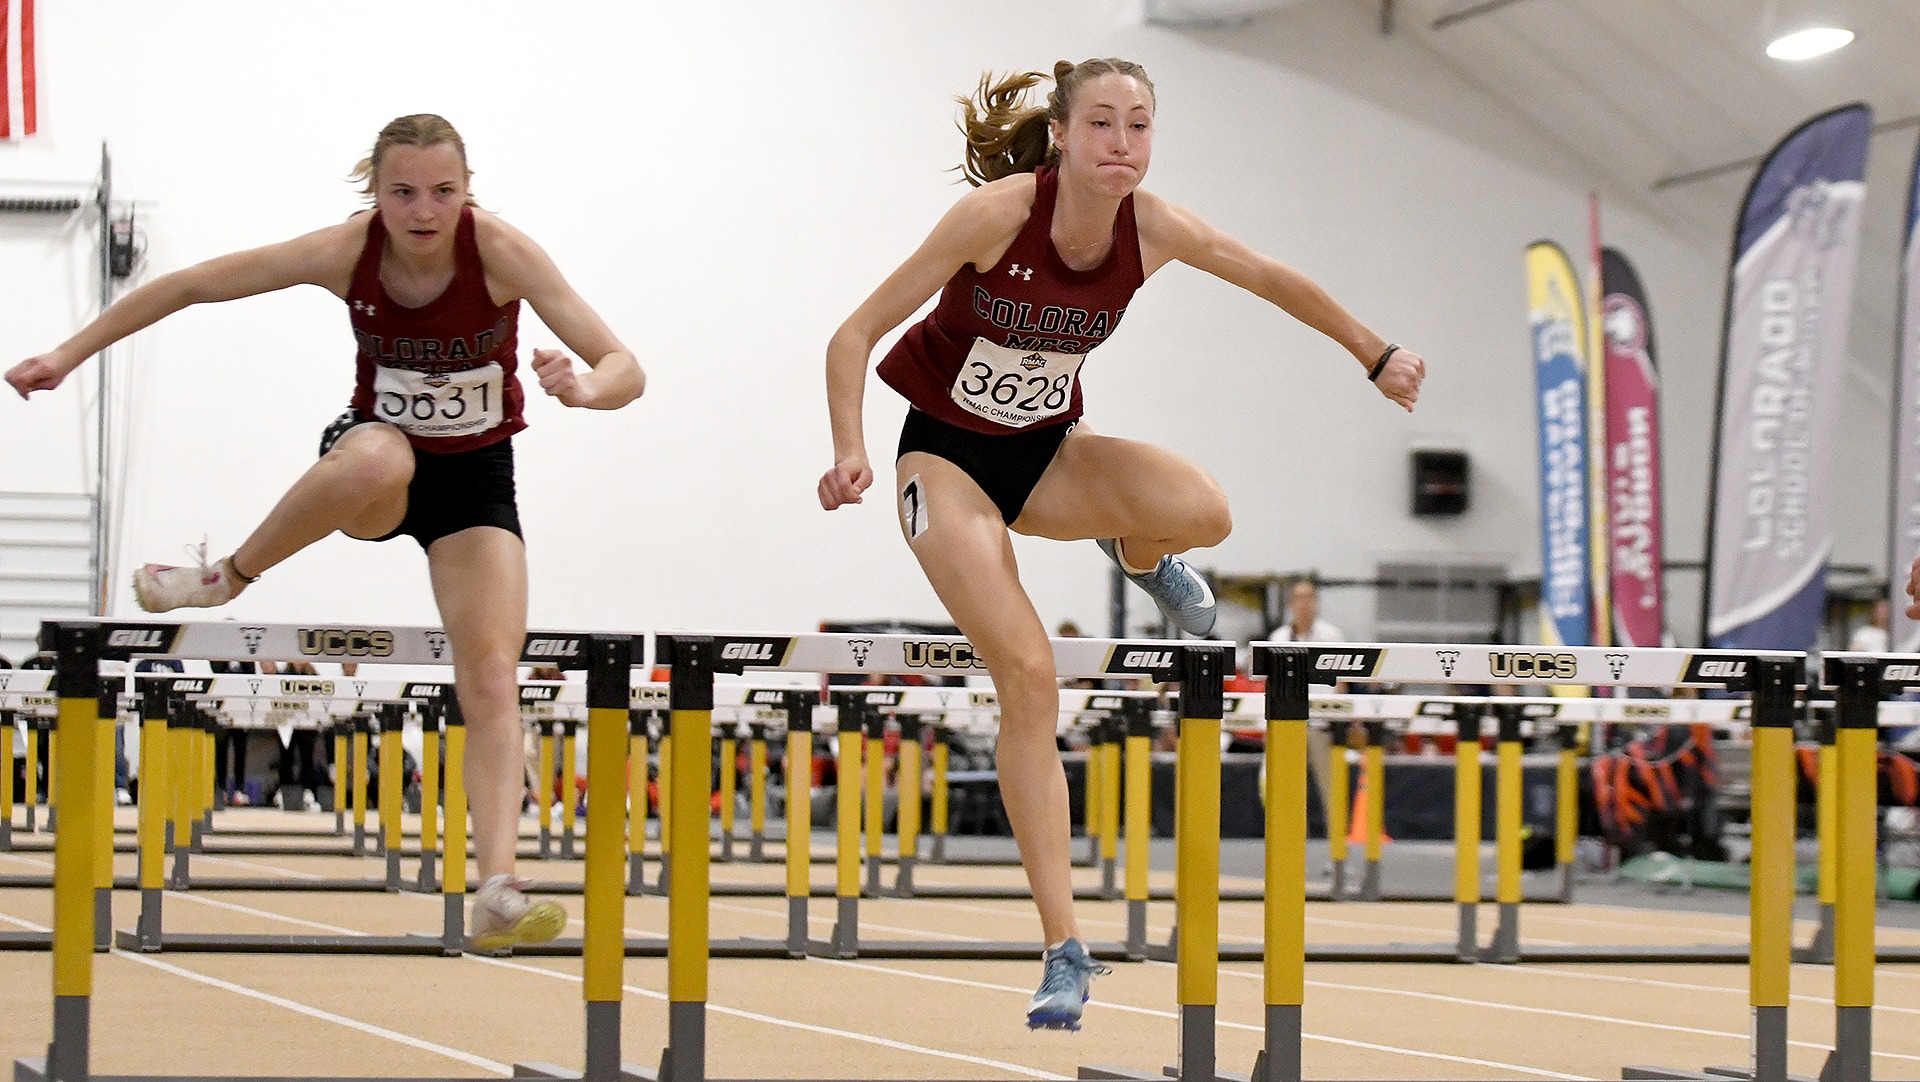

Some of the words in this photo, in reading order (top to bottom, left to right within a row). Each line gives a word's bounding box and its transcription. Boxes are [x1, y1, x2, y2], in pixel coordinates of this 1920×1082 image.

[961, 361, 1069, 412] 3628
[108, 629, 163, 647] GILL
[298, 628, 394, 656] UCCS
[525, 639, 580, 656] GILL
[721, 643, 775, 660] GILL
[1123, 651, 1174, 668] GILL
[1315, 653, 1366, 671] GILL
[1488, 652, 1577, 678] UCCS
[1698, 660, 1747, 677] GILL
[173, 679, 204, 692] GILL
[280, 679, 335, 695] UCCS
[410, 684, 441, 697] GILL
[521, 687, 551, 699] GILL
